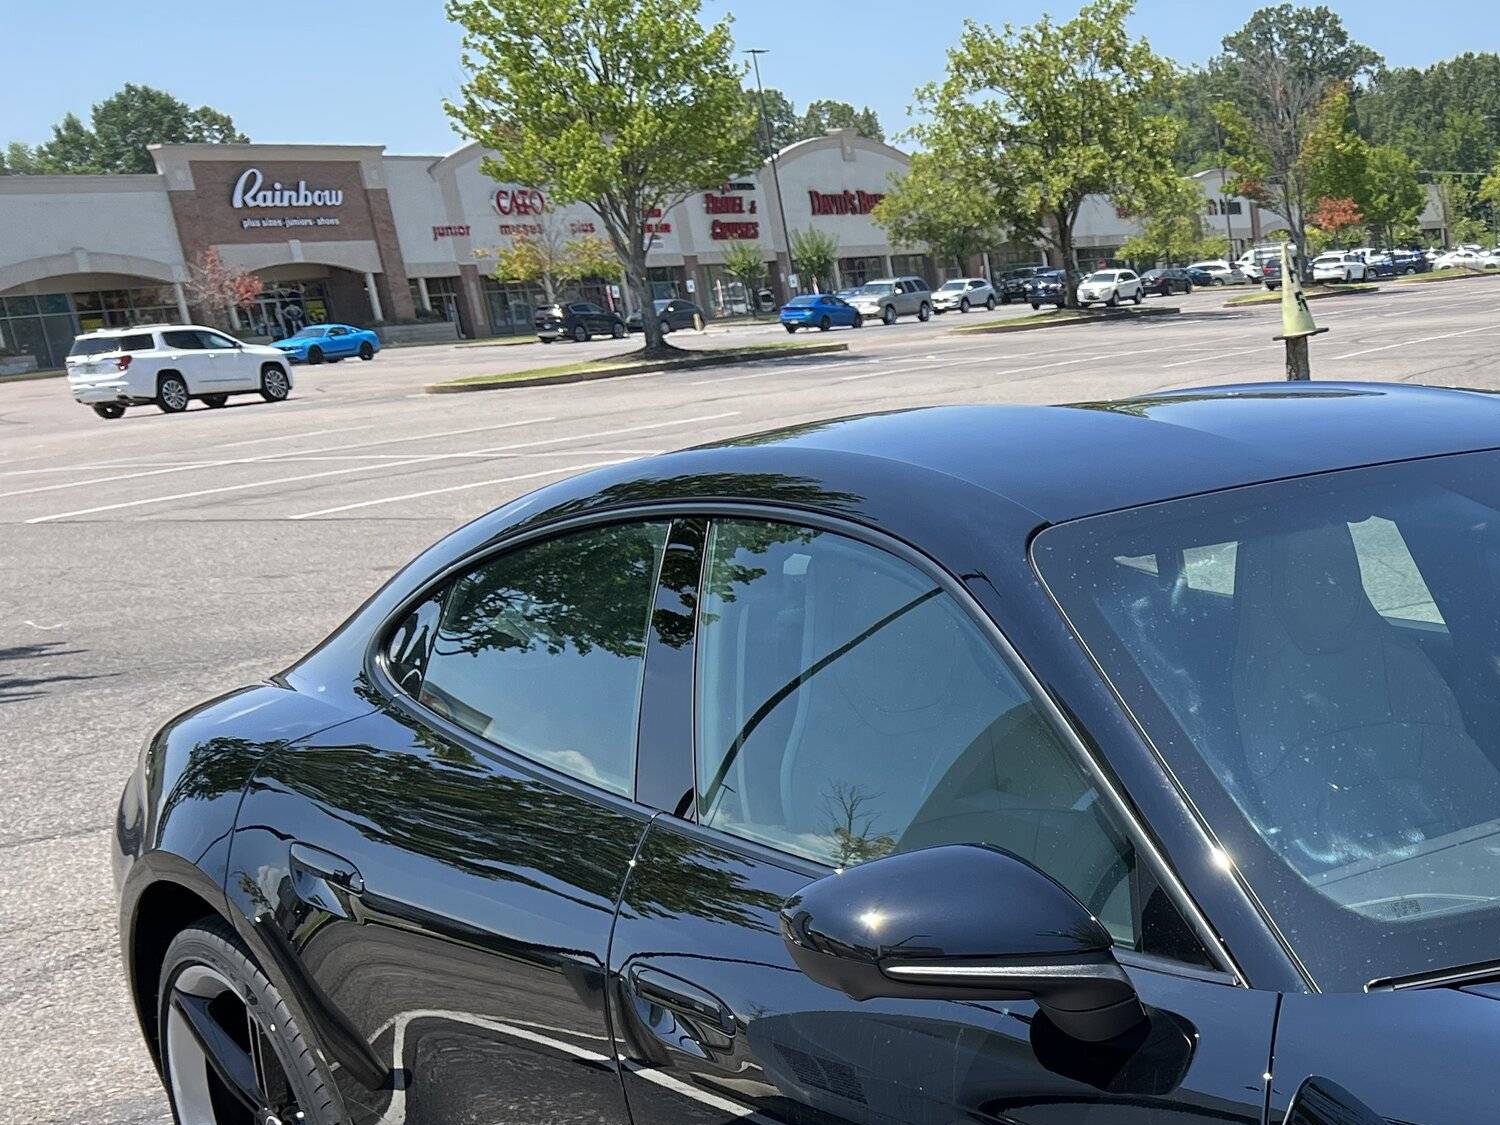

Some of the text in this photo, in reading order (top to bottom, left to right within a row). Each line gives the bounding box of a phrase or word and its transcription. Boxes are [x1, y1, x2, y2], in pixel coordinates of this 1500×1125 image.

[232, 168, 344, 209] Rainbow
[495, 190, 545, 216] CATO
[432, 225, 471, 241] junior
